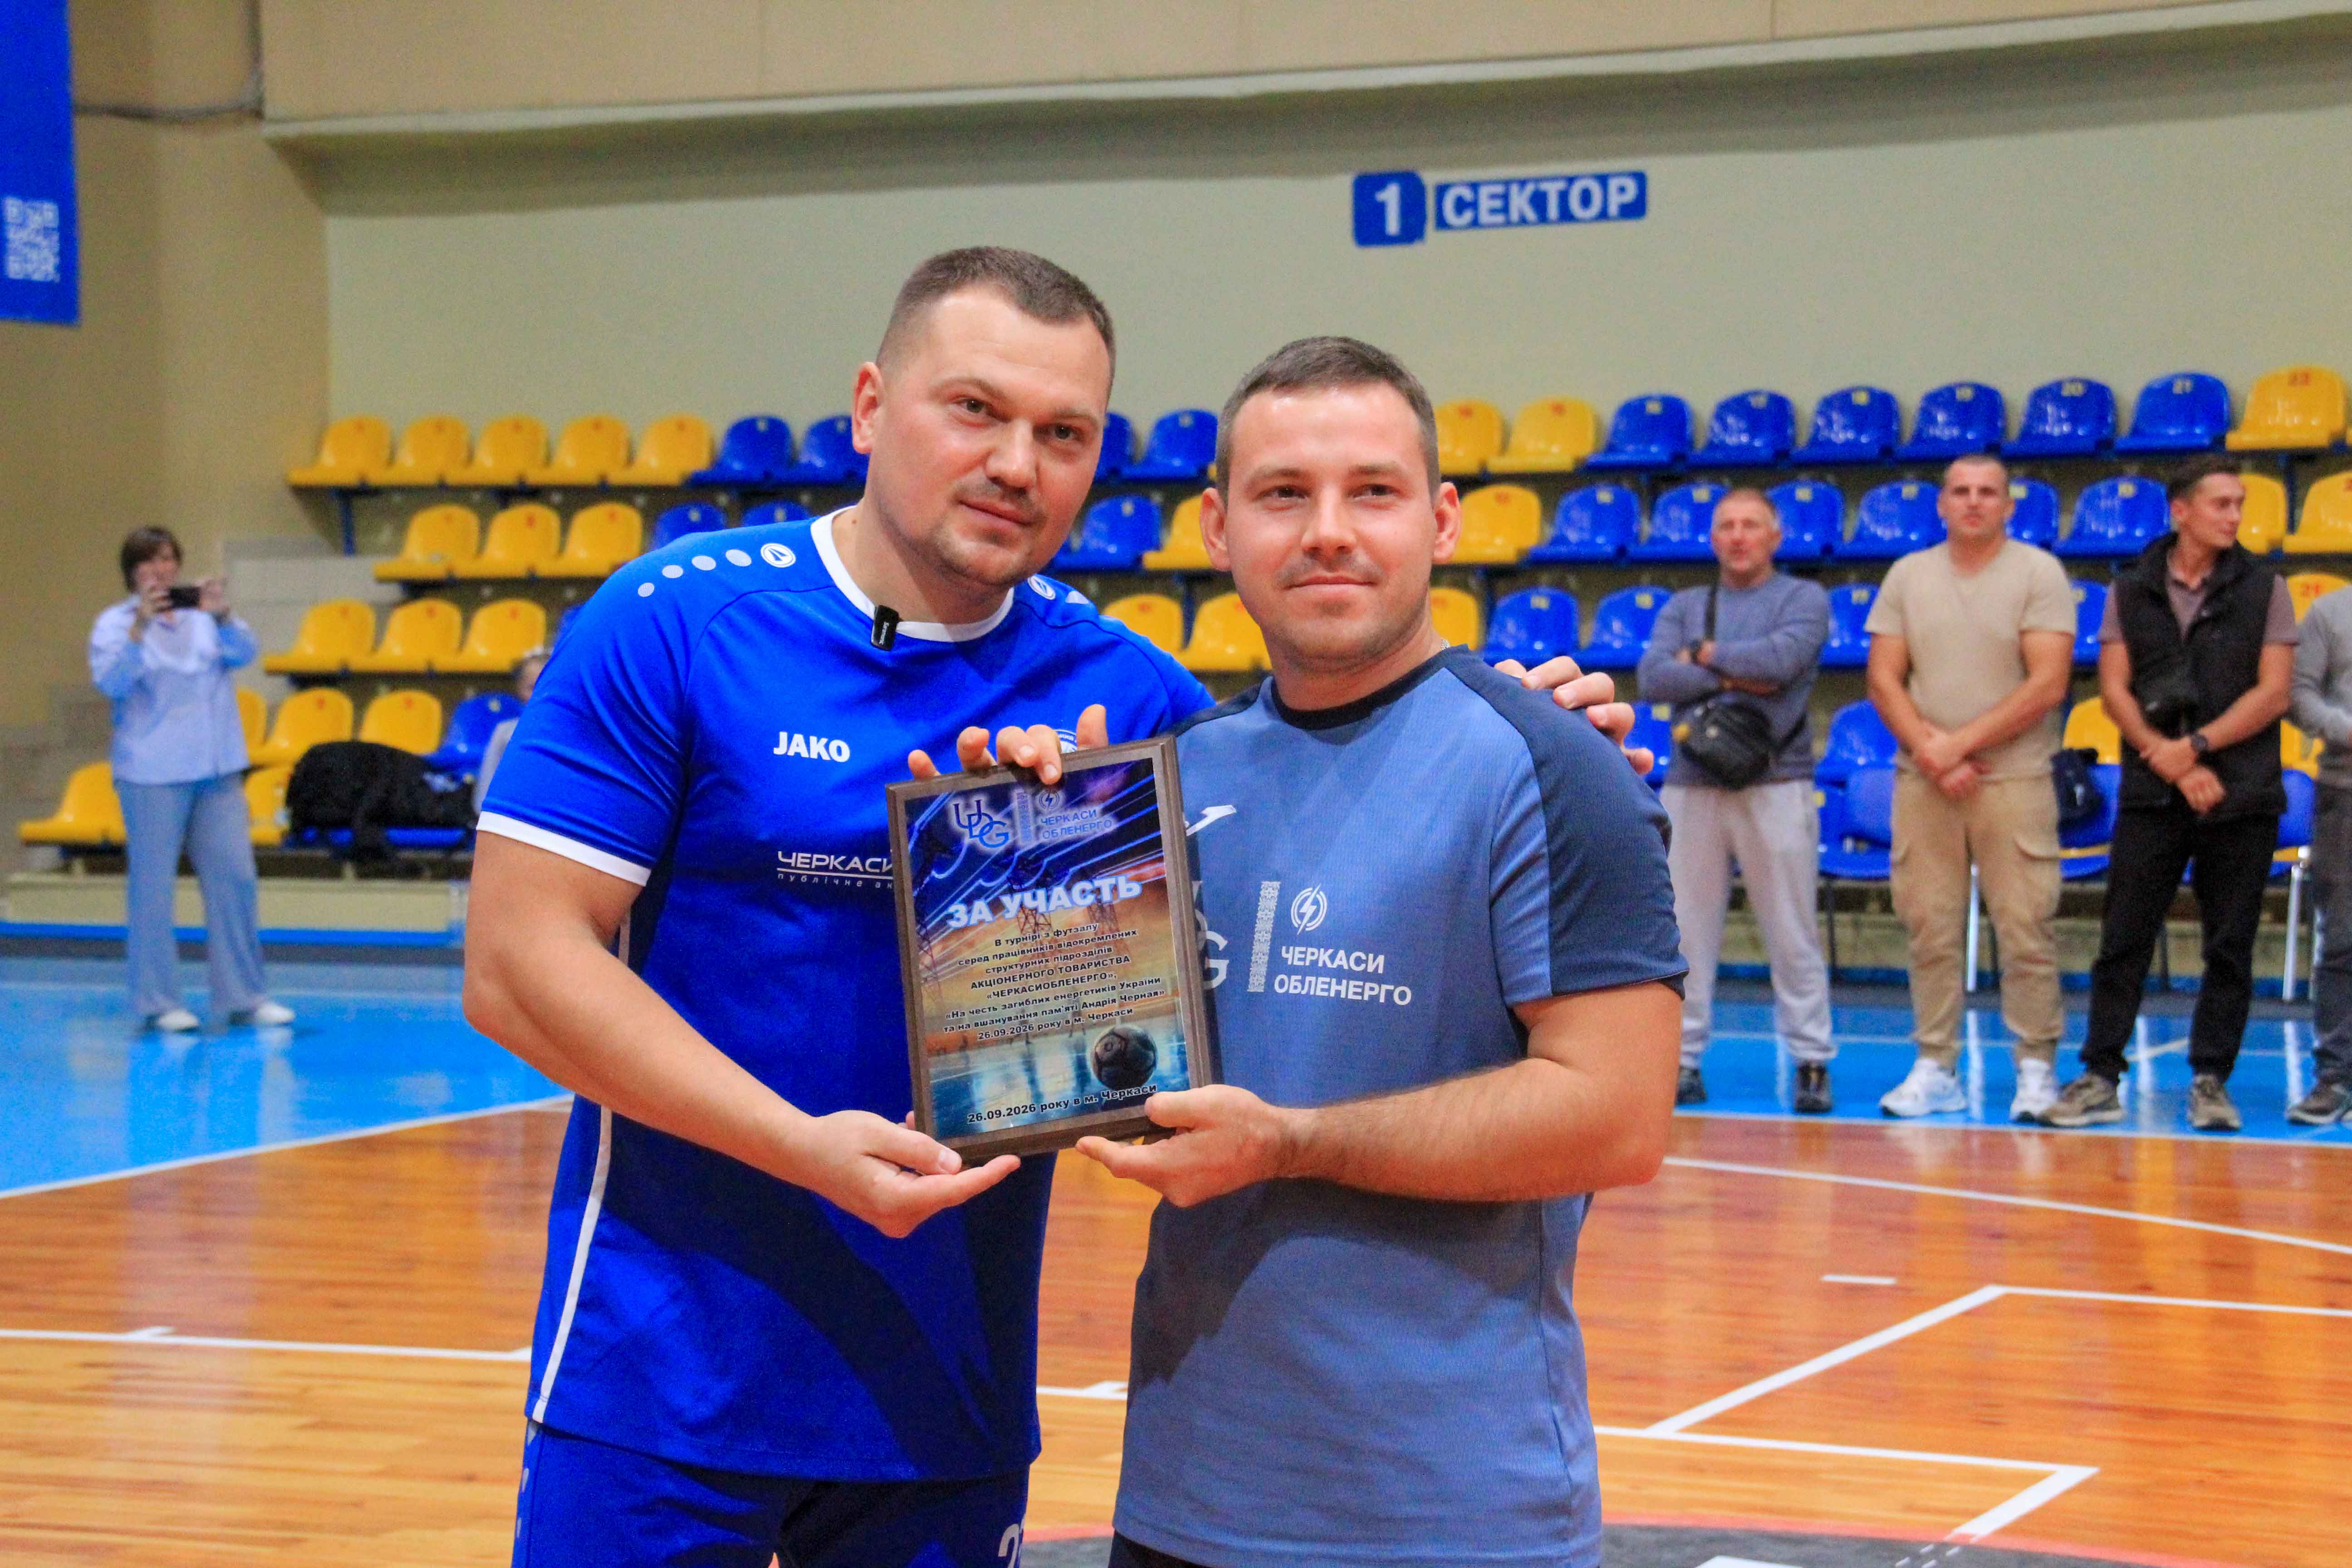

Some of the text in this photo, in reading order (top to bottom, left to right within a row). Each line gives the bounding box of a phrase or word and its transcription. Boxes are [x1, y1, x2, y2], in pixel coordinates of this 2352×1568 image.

[1375, 176, 1638, 235] 1 СЕКТОР
[773, 731, 850, 763] JAKO
[1041, 809, 1097, 826] ЧЕРКАСИ
[1044, 819, 1112, 839] ОБЛЕНЕРГО
[778, 872, 862, 887] публічне
[947, 874, 1142, 928] ЗА УЧАСТЬ
[958, 930, 1137, 965] серед працівників відокремлених
[1005, 934, 1040, 946] турнірі
[1054, 924, 1098, 938] футзалу
[971, 956, 1131, 989] АКЦІОНЕРНОГО ТОВАРИСТВА
[985, 947, 1112, 974] структурних підрозділів
[1281, 946, 1385, 974] ЧЕРКАСИ
[946, 977, 1161, 1019] «На честь загиблих енергетиків України
[987, 972, 1117, 999] «ЧЕРКАСИОБЛЕНЕРГО»,
[1274, 974, 1411, 1005] ОБЛЕНЕРГО
[974, 1012, 1038, 1028] вшанування
[1042, 1003, 1078, 1015] пам'яті
[1082, 998, 1116, 1009] Андрія
[978, 1024, 1034, 1039] 26.09.2026
[1038, 1021, 1061, 1031] року
[1088, 1009, 1133, 1020] Черкаси
[968, 1103, 1036, 1123] 26.09.2026
[1040, 1098, 1069, 1112] року
[1085, 1095, 1098, 1103] м.
[1102, 1084, 1157, 1100] Черкаси
